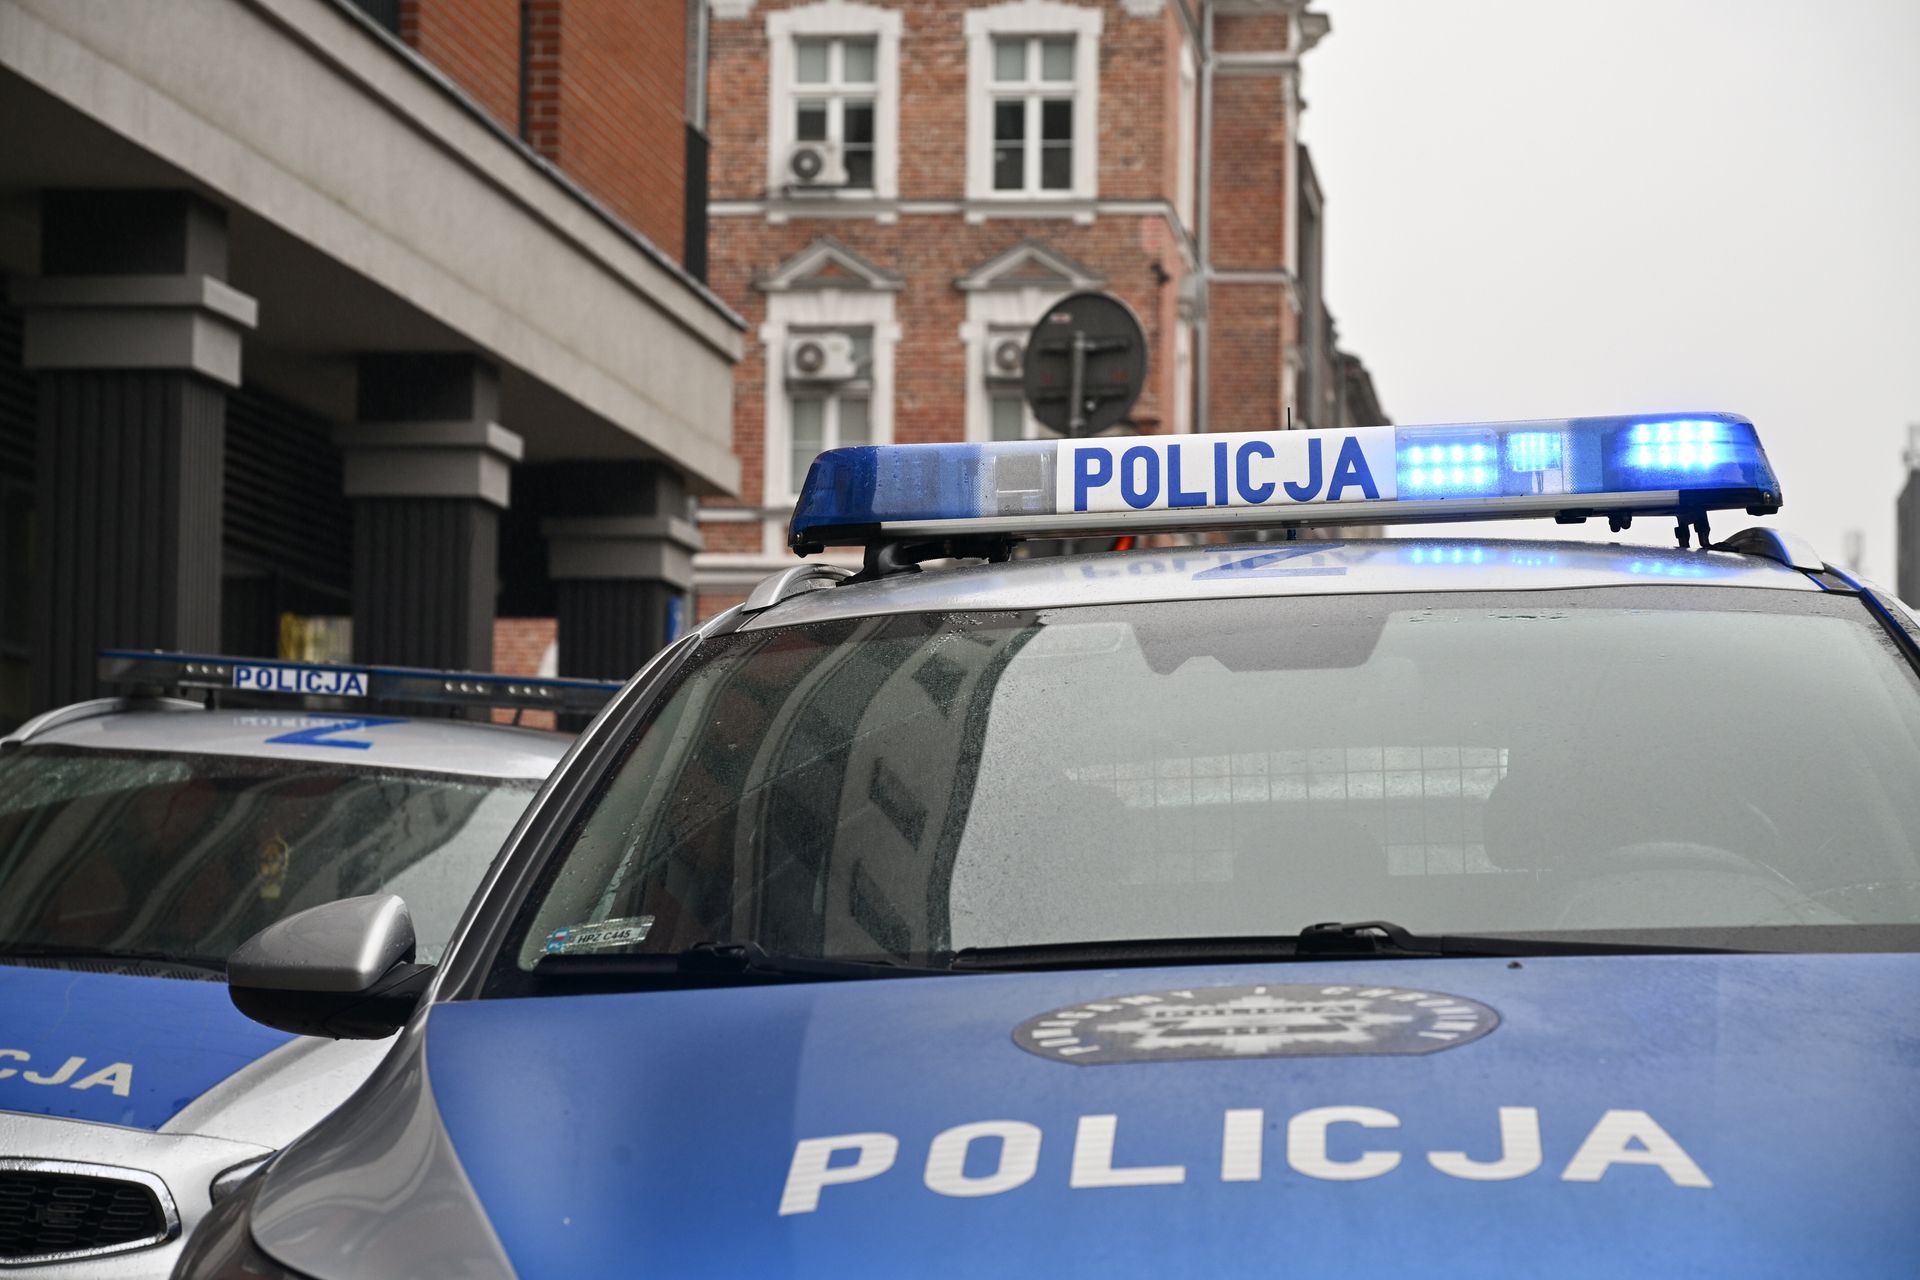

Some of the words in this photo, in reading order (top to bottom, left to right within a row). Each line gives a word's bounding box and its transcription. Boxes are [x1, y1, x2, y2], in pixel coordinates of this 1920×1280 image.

[1073, 436, 1381, 512] POLICJA
[235, 667, 364, 696] POLICJA
[577, 934, 600, 944] HPZ
[603, 929, 632, 941] C445
[779, 1106, 1714, 1216] POLICJA
